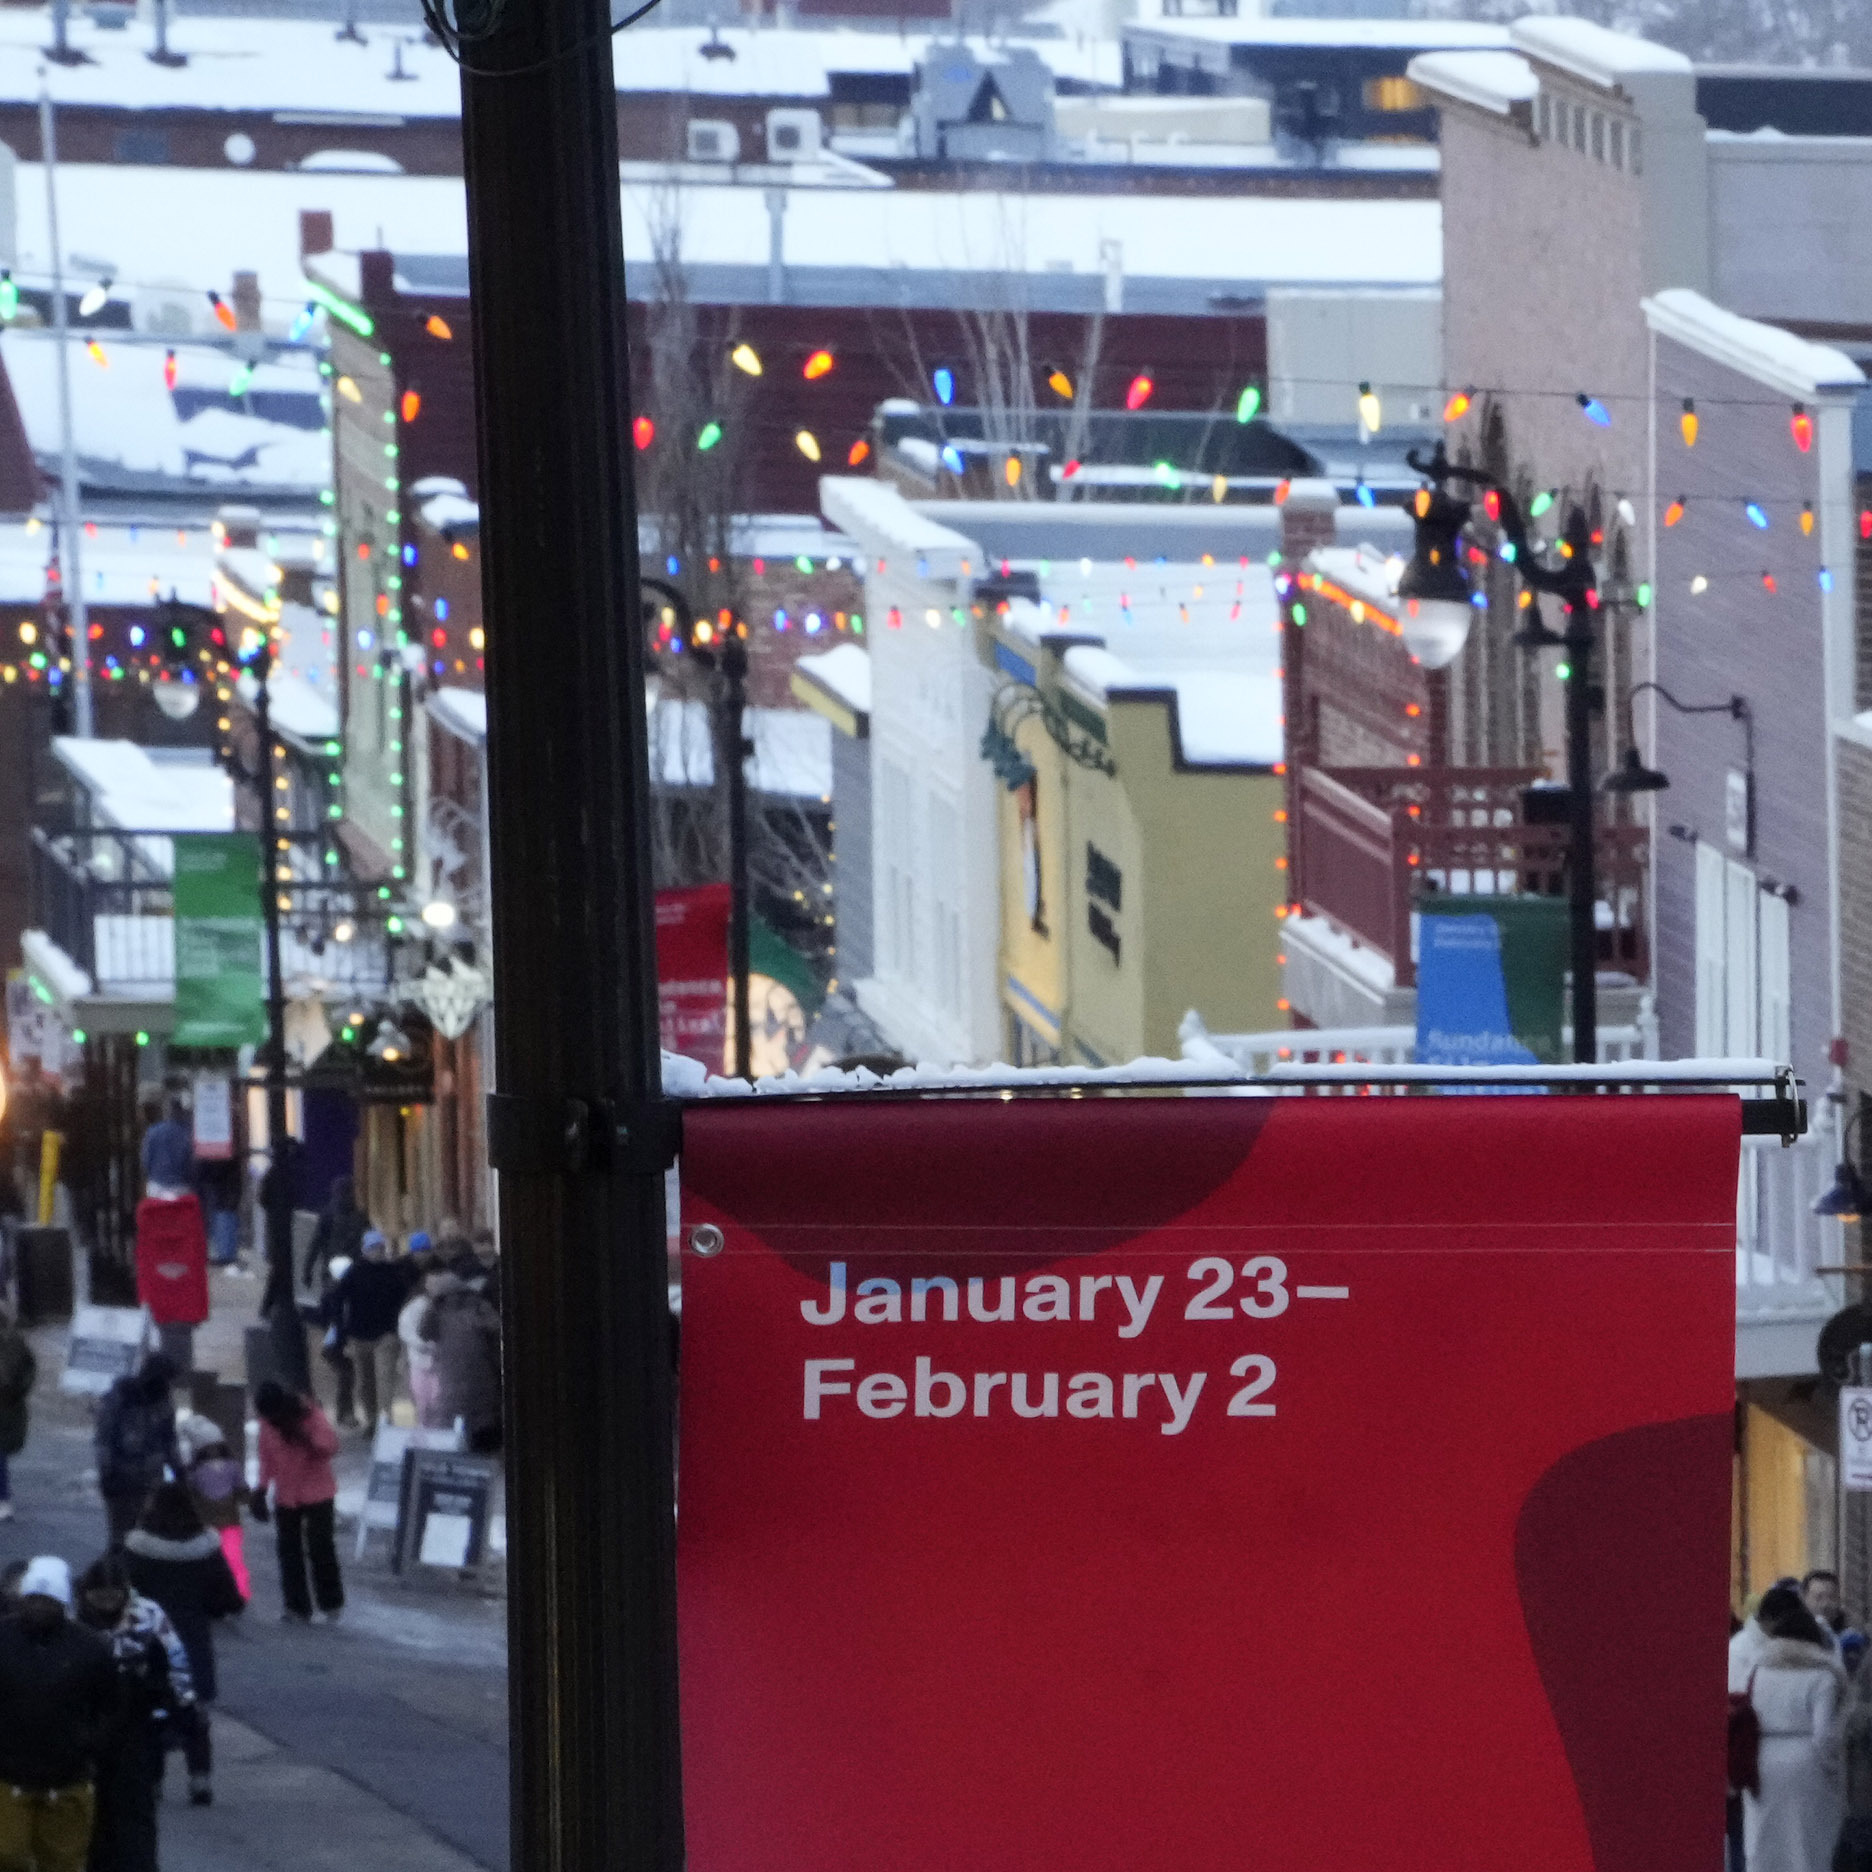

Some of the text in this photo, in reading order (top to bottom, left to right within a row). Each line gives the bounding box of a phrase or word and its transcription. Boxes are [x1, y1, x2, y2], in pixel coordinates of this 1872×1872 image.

[800, 1261, 1164, 1338] January
[803, 1353, 1278, 1435] February 2
